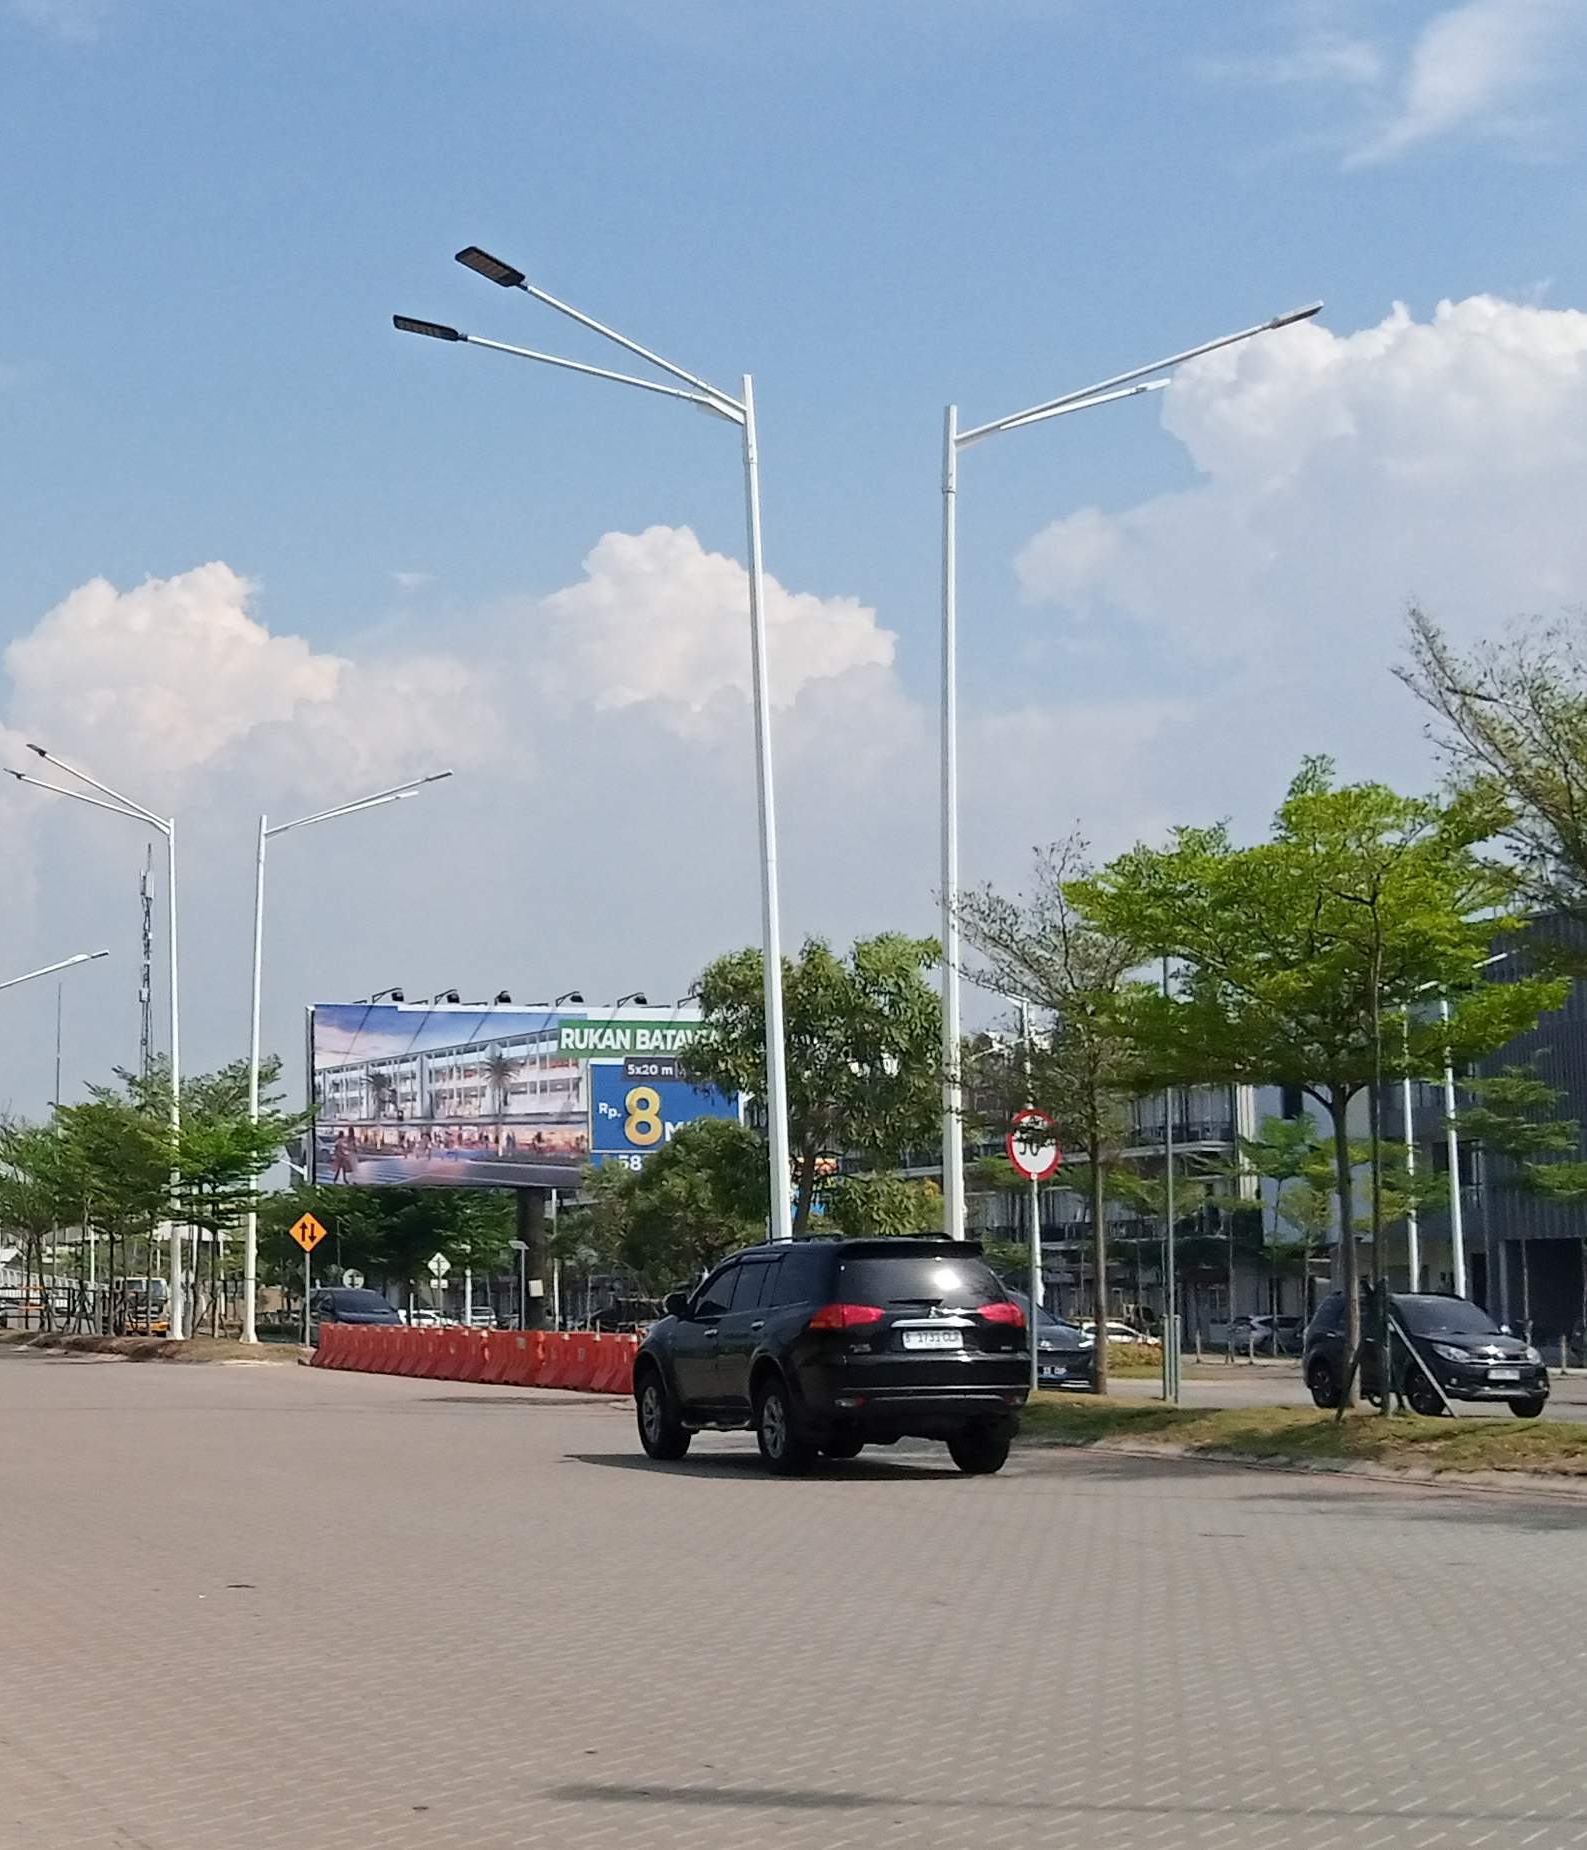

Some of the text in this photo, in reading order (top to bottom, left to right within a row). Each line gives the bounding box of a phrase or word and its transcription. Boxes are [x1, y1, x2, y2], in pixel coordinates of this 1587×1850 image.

[560, 1028, 631, 1050] RUKAN
[627, 1065, 673, 1076] 5x20 m
[598, 1102, 622, 1119] Rp.
[624, 1086, 664, 1146] 8
